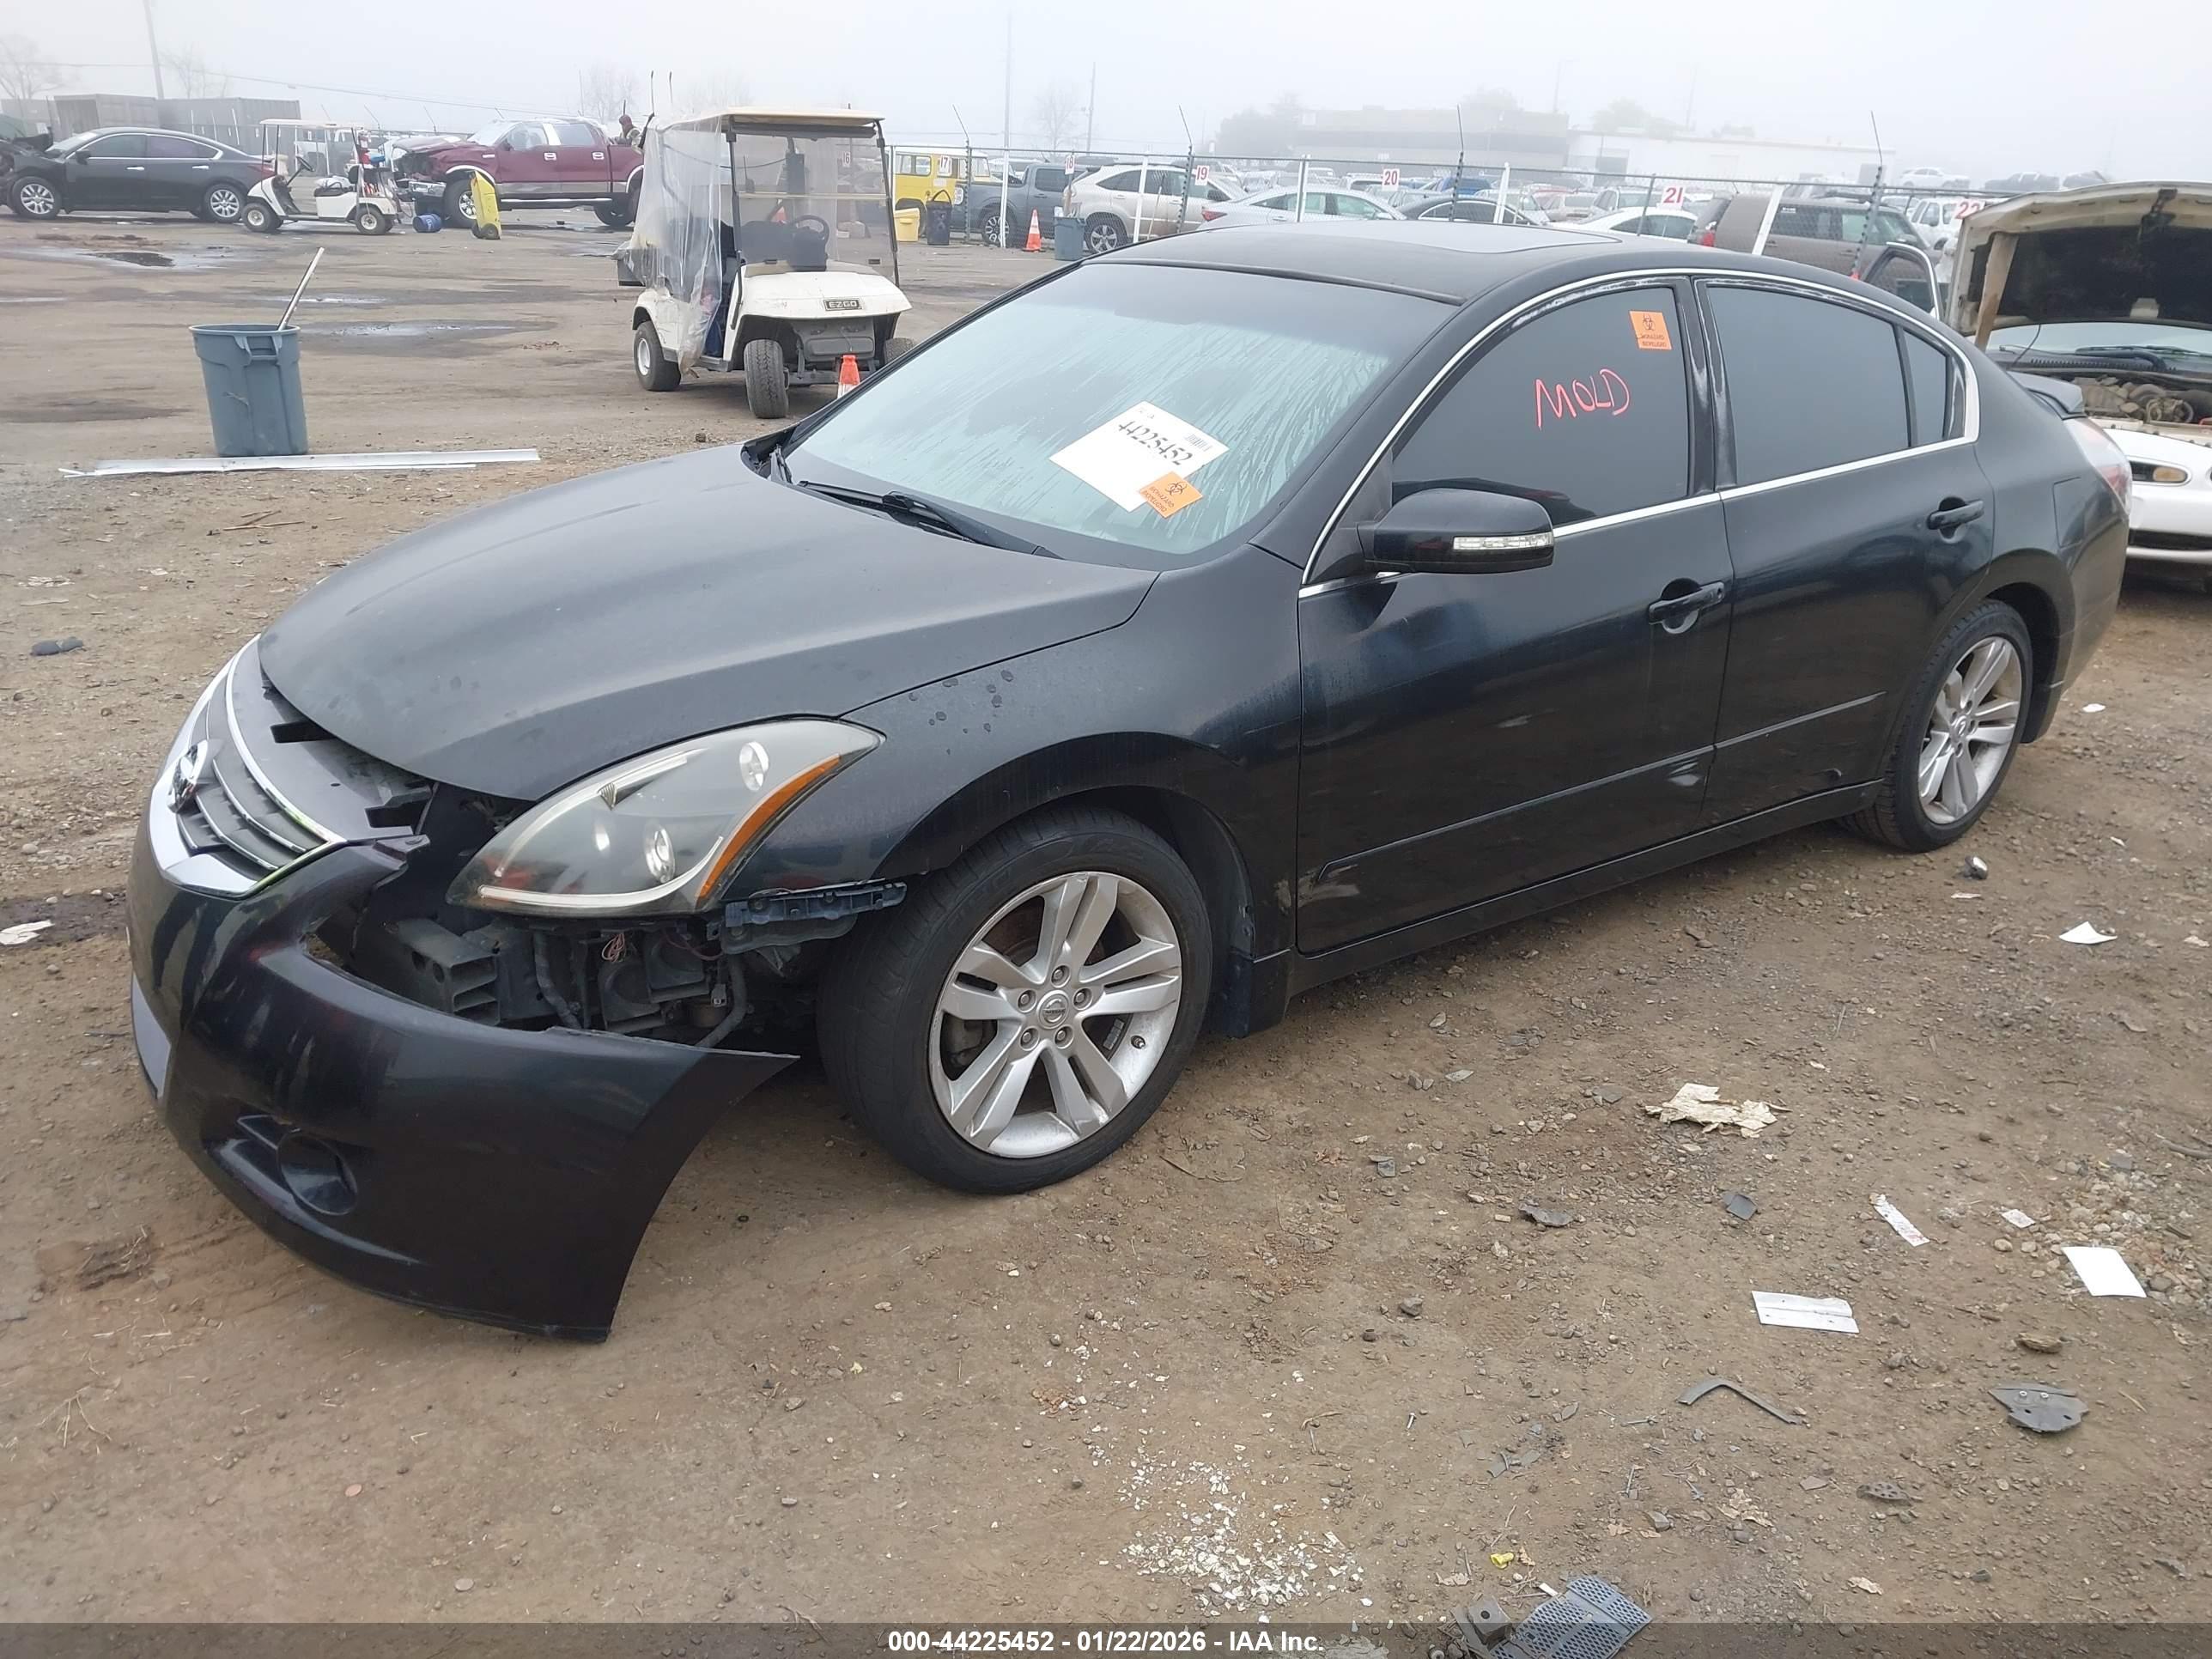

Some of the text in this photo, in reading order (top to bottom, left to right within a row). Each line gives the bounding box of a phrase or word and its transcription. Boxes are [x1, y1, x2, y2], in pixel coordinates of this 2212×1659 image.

[940, 156, 949, 168] 17
[1197, 167, 1207, 179] 19
[1383, 170, 1398, 185] 20
[1663, 186, 1683, 204] 21
[1534, 368, 1631, 431] MOLD
[1117, 420, 1194, 466] 44225452
